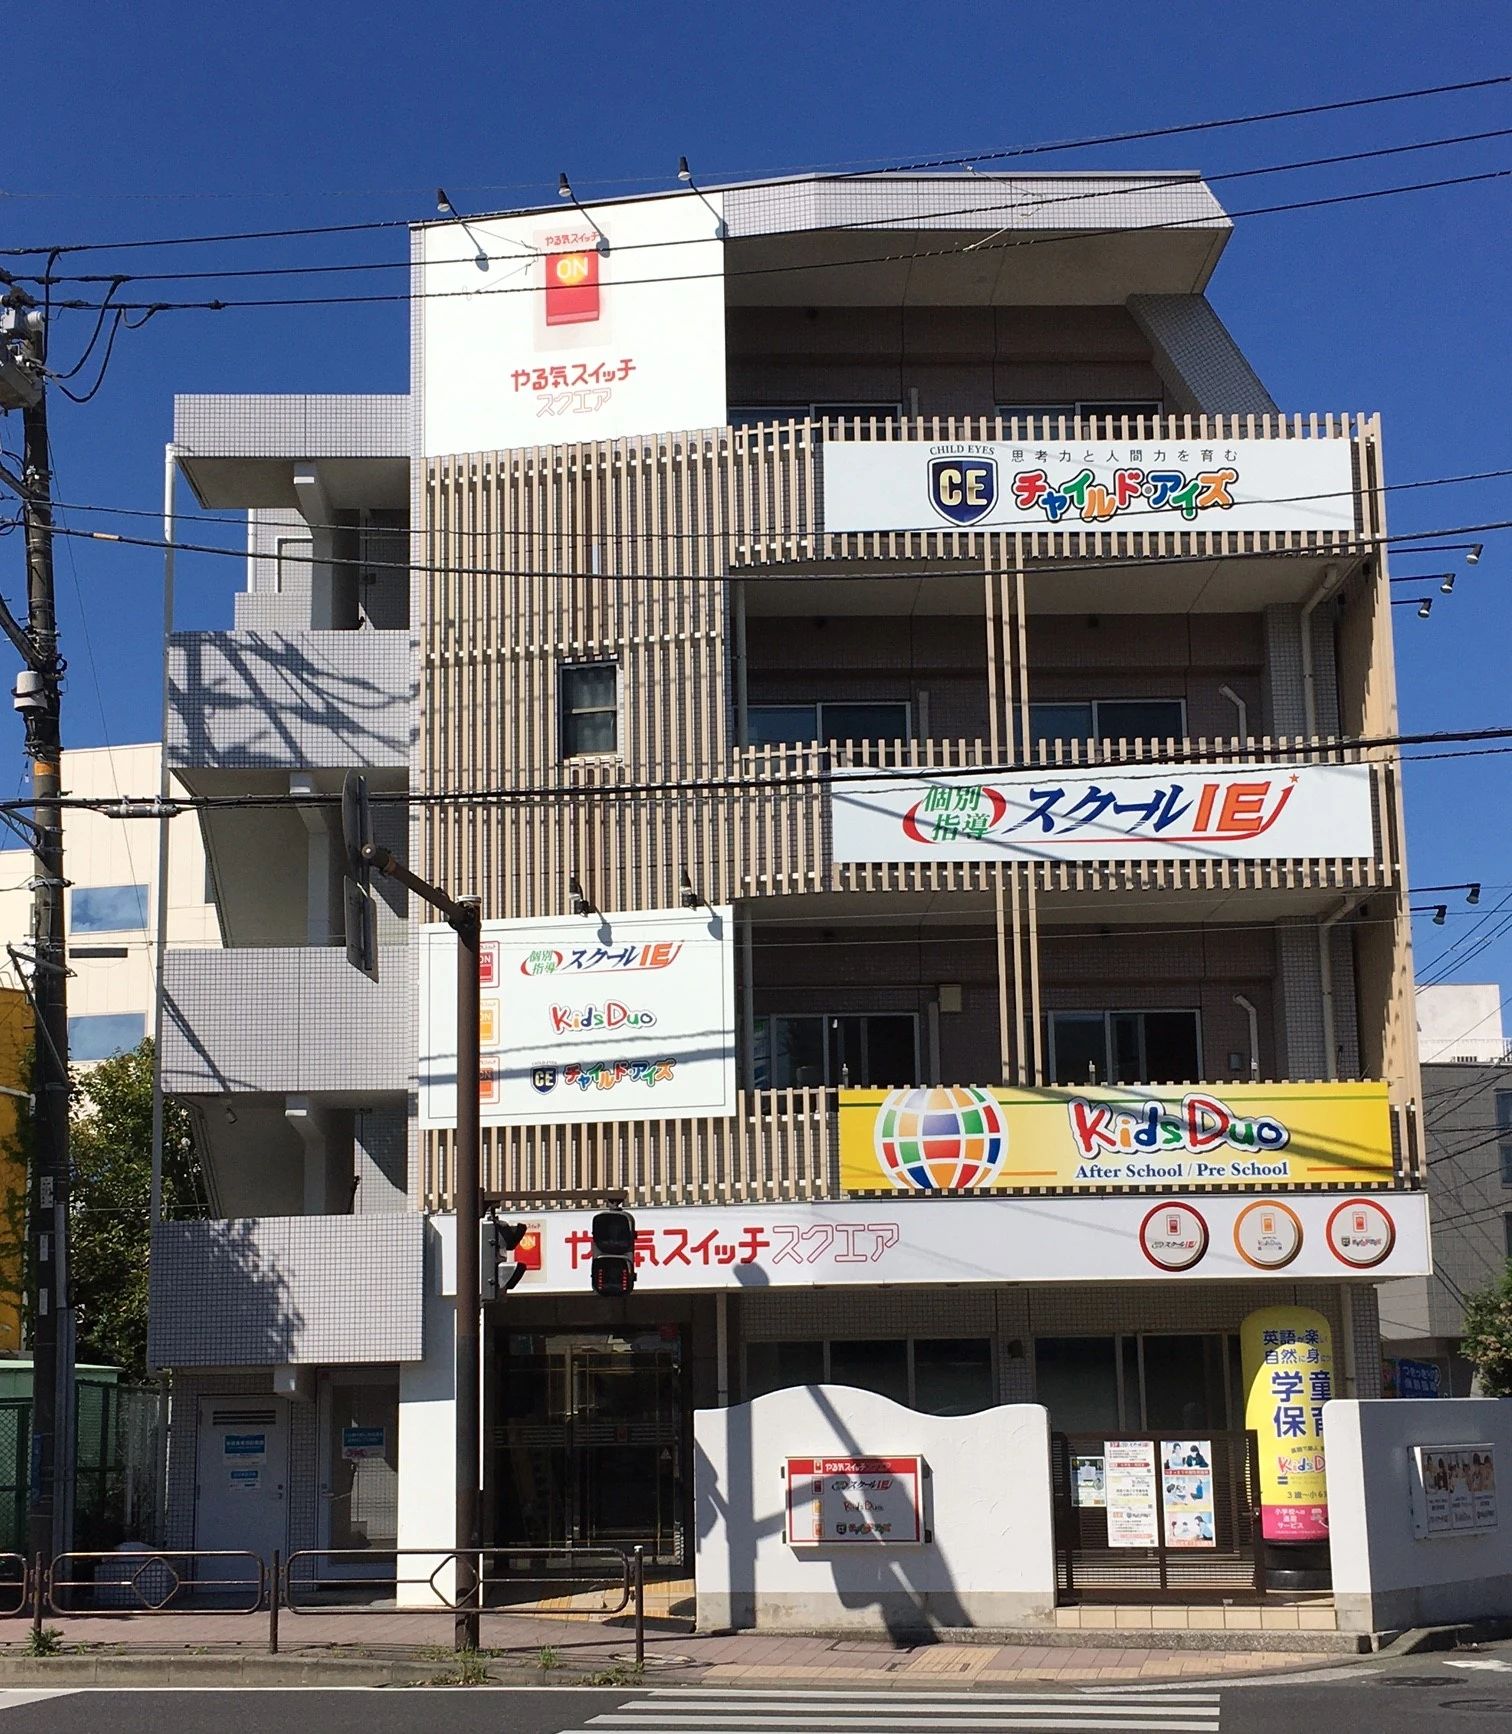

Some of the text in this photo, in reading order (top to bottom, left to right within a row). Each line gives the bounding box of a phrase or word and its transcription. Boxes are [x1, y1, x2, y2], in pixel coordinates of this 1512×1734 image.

[556, 256, 589, 280] ON
[510, 358, 636, 392] やる気スイッチ
[536, 387, 613, 418] スクエア
[929, 444, 995, 456] CHILD EYES
[939, 469, 988, 507] CE
[922, 784, 982, 813] 個別
[931, 813, 996, 842] 指導
[533, 1070, 555, 1088] CE
[1075, 1164, 1121, 1179] After
[1125, 1163, 1184, 1179] School
[1197, 1163, 1227, 1177] Pre
[1231, 1161, 1288, 1177] School
[1271, 1370, 1332, 1403] 学童
